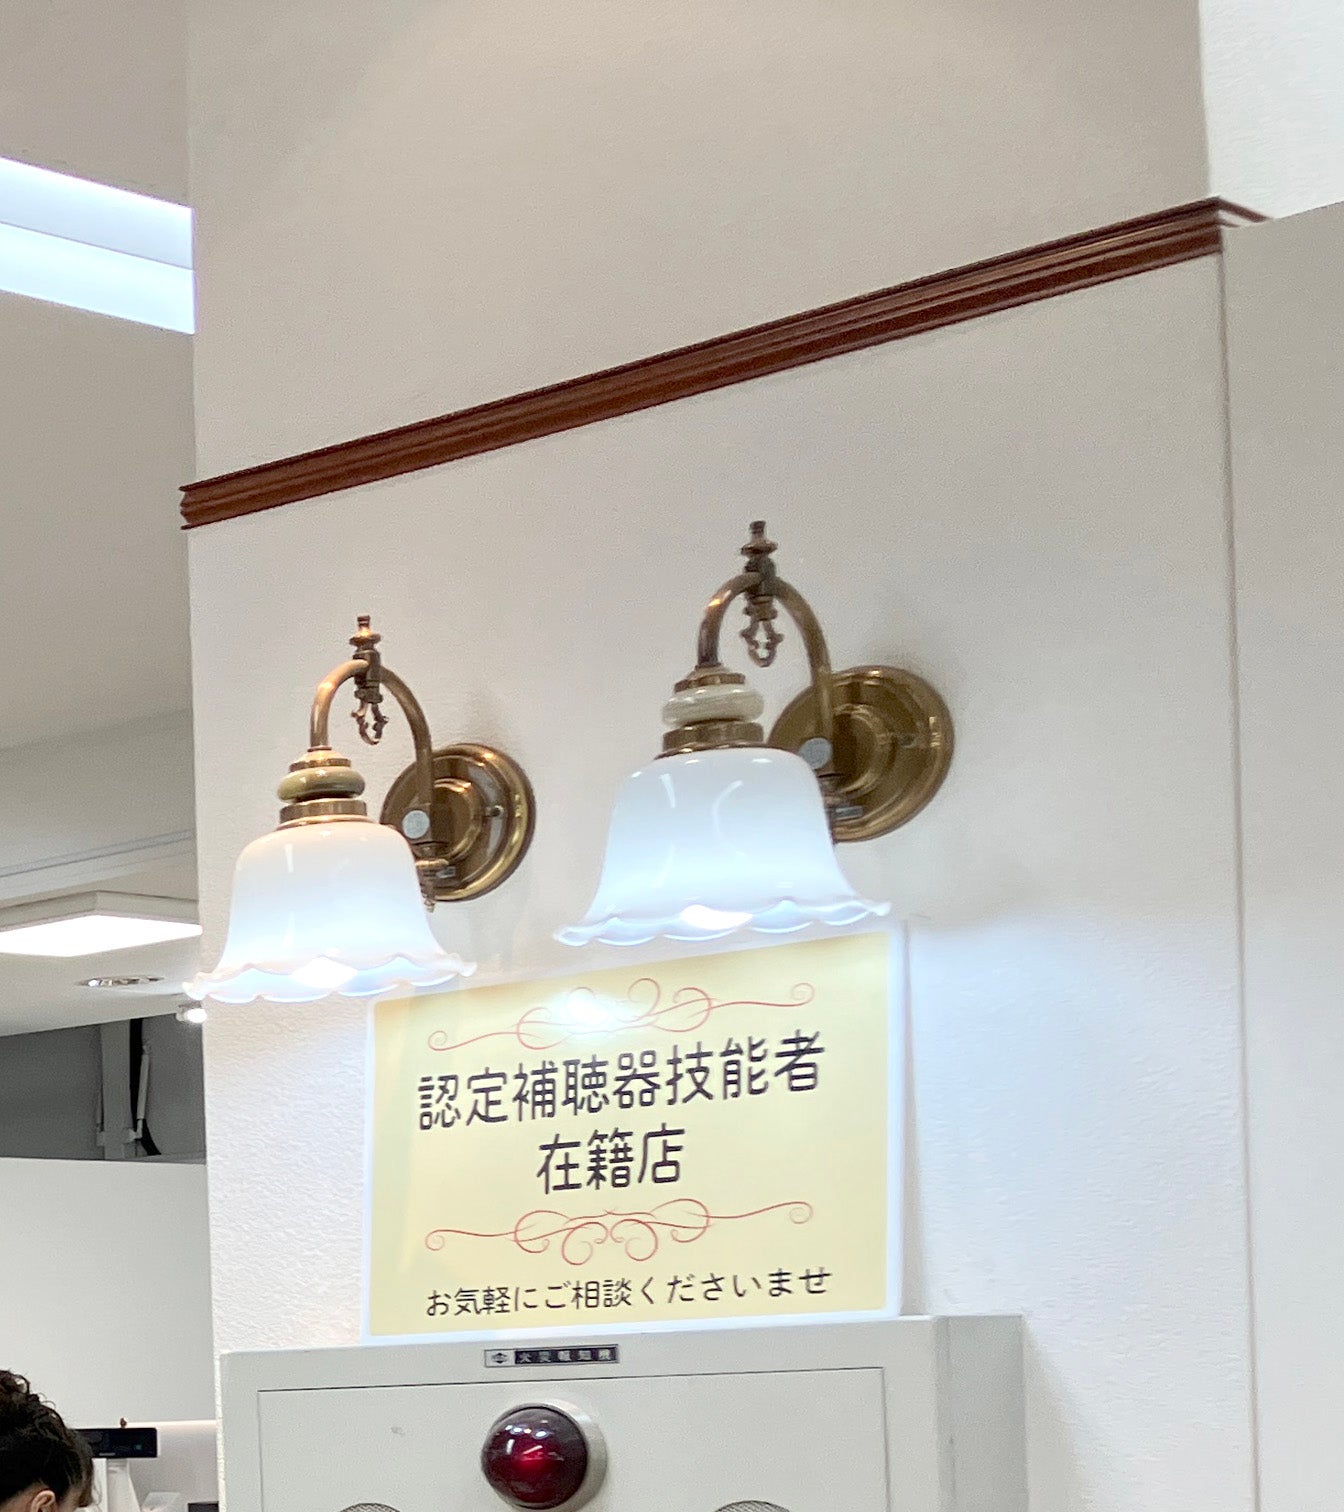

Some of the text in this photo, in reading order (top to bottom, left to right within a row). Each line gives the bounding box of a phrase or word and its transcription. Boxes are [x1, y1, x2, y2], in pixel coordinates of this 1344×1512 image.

[417, 1028, 826, 1131] 認定補聴器技能者
[536, 1123, 687, 1196] 在籍店
[425, 1266, 833, 1318] お気軽にご相談くださいませ
